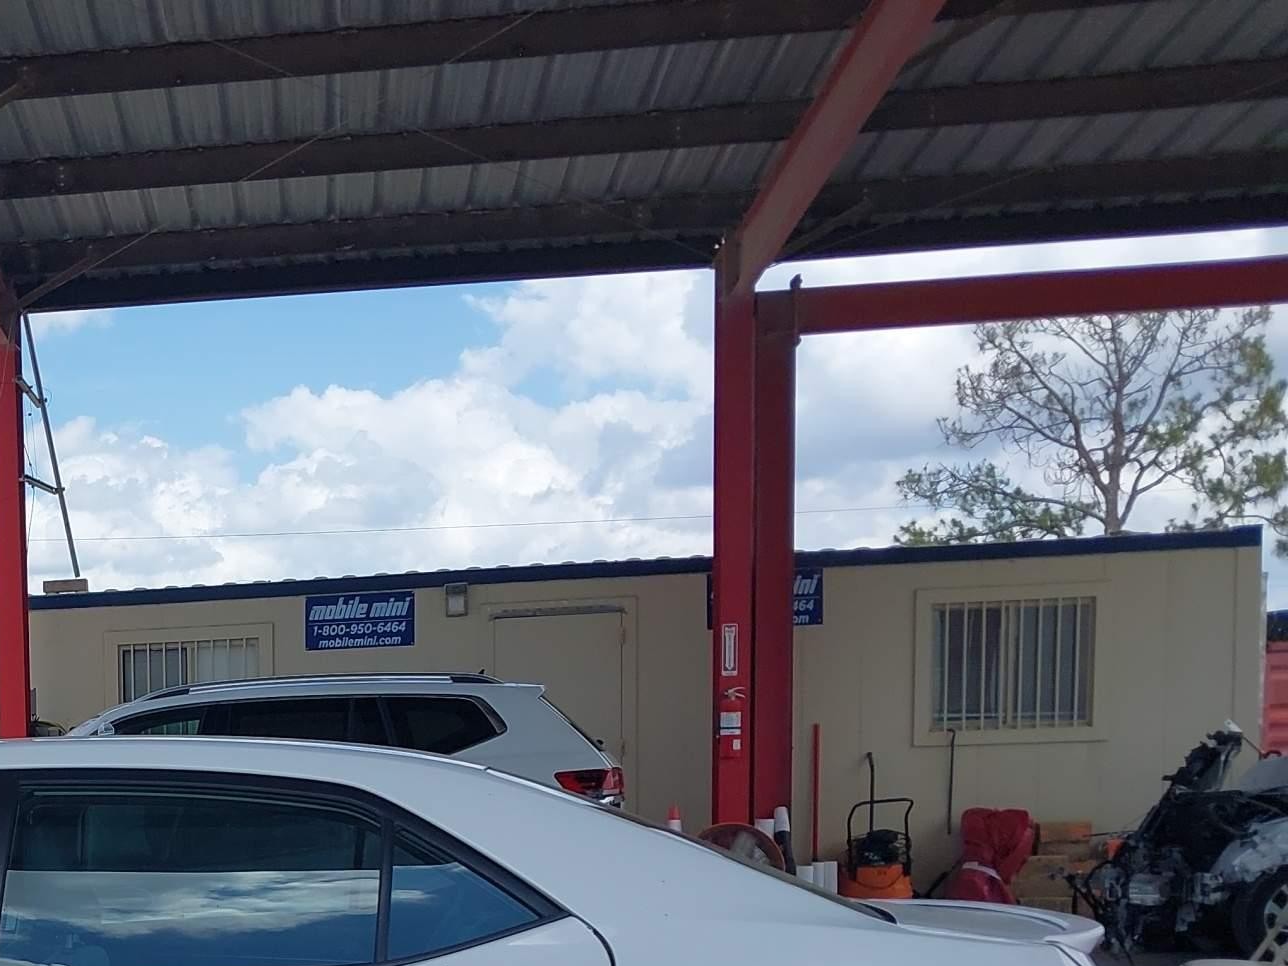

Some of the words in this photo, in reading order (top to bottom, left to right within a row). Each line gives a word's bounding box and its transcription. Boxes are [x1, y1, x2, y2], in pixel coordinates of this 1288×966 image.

[793, 574, 818, 595] ini
[308, 595, 368, 621] mobile
[369, 597, 411, 618] mini
[312, 621, 406, 637] 1-800-950-6464
[318, 634, 402, 649] mobilemini.com
